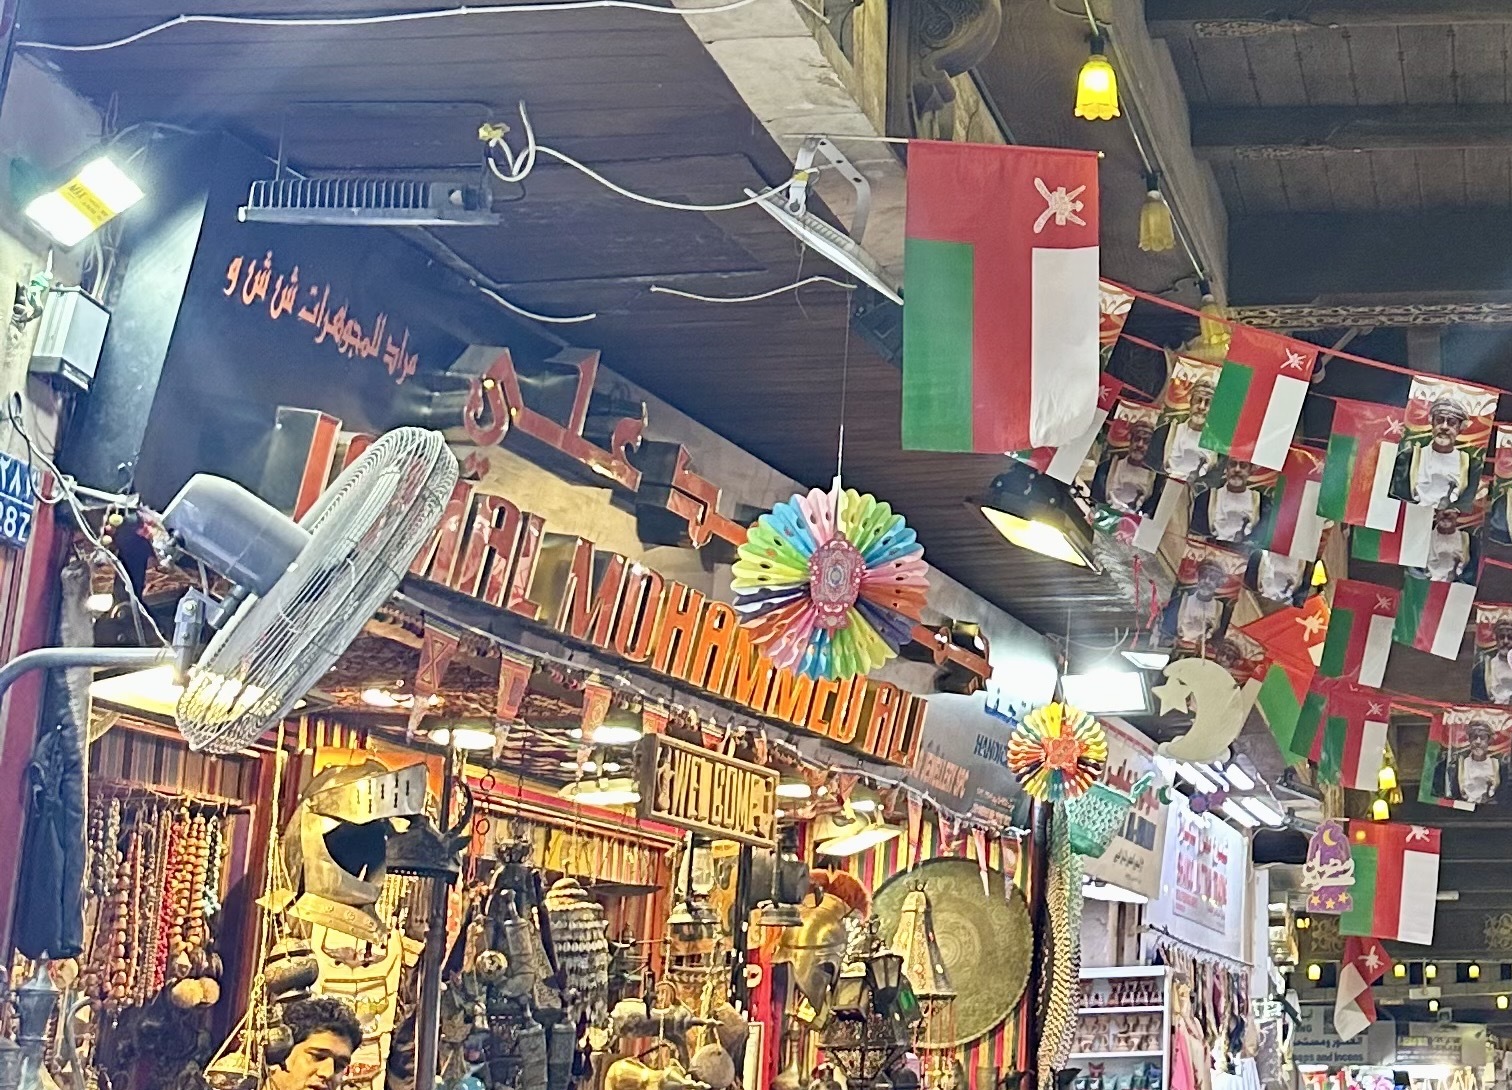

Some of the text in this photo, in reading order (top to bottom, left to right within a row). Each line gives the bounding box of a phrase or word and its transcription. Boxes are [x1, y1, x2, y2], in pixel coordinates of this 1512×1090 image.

[223, 250, 418, 385] مراد للمجوهرات ش ش و
[463, 347, 648, 493] علي
[0, 498, 31, 542] 87
[863, 682, 930, 769] ALI
[673, 748, 775, 841] WELCOME
